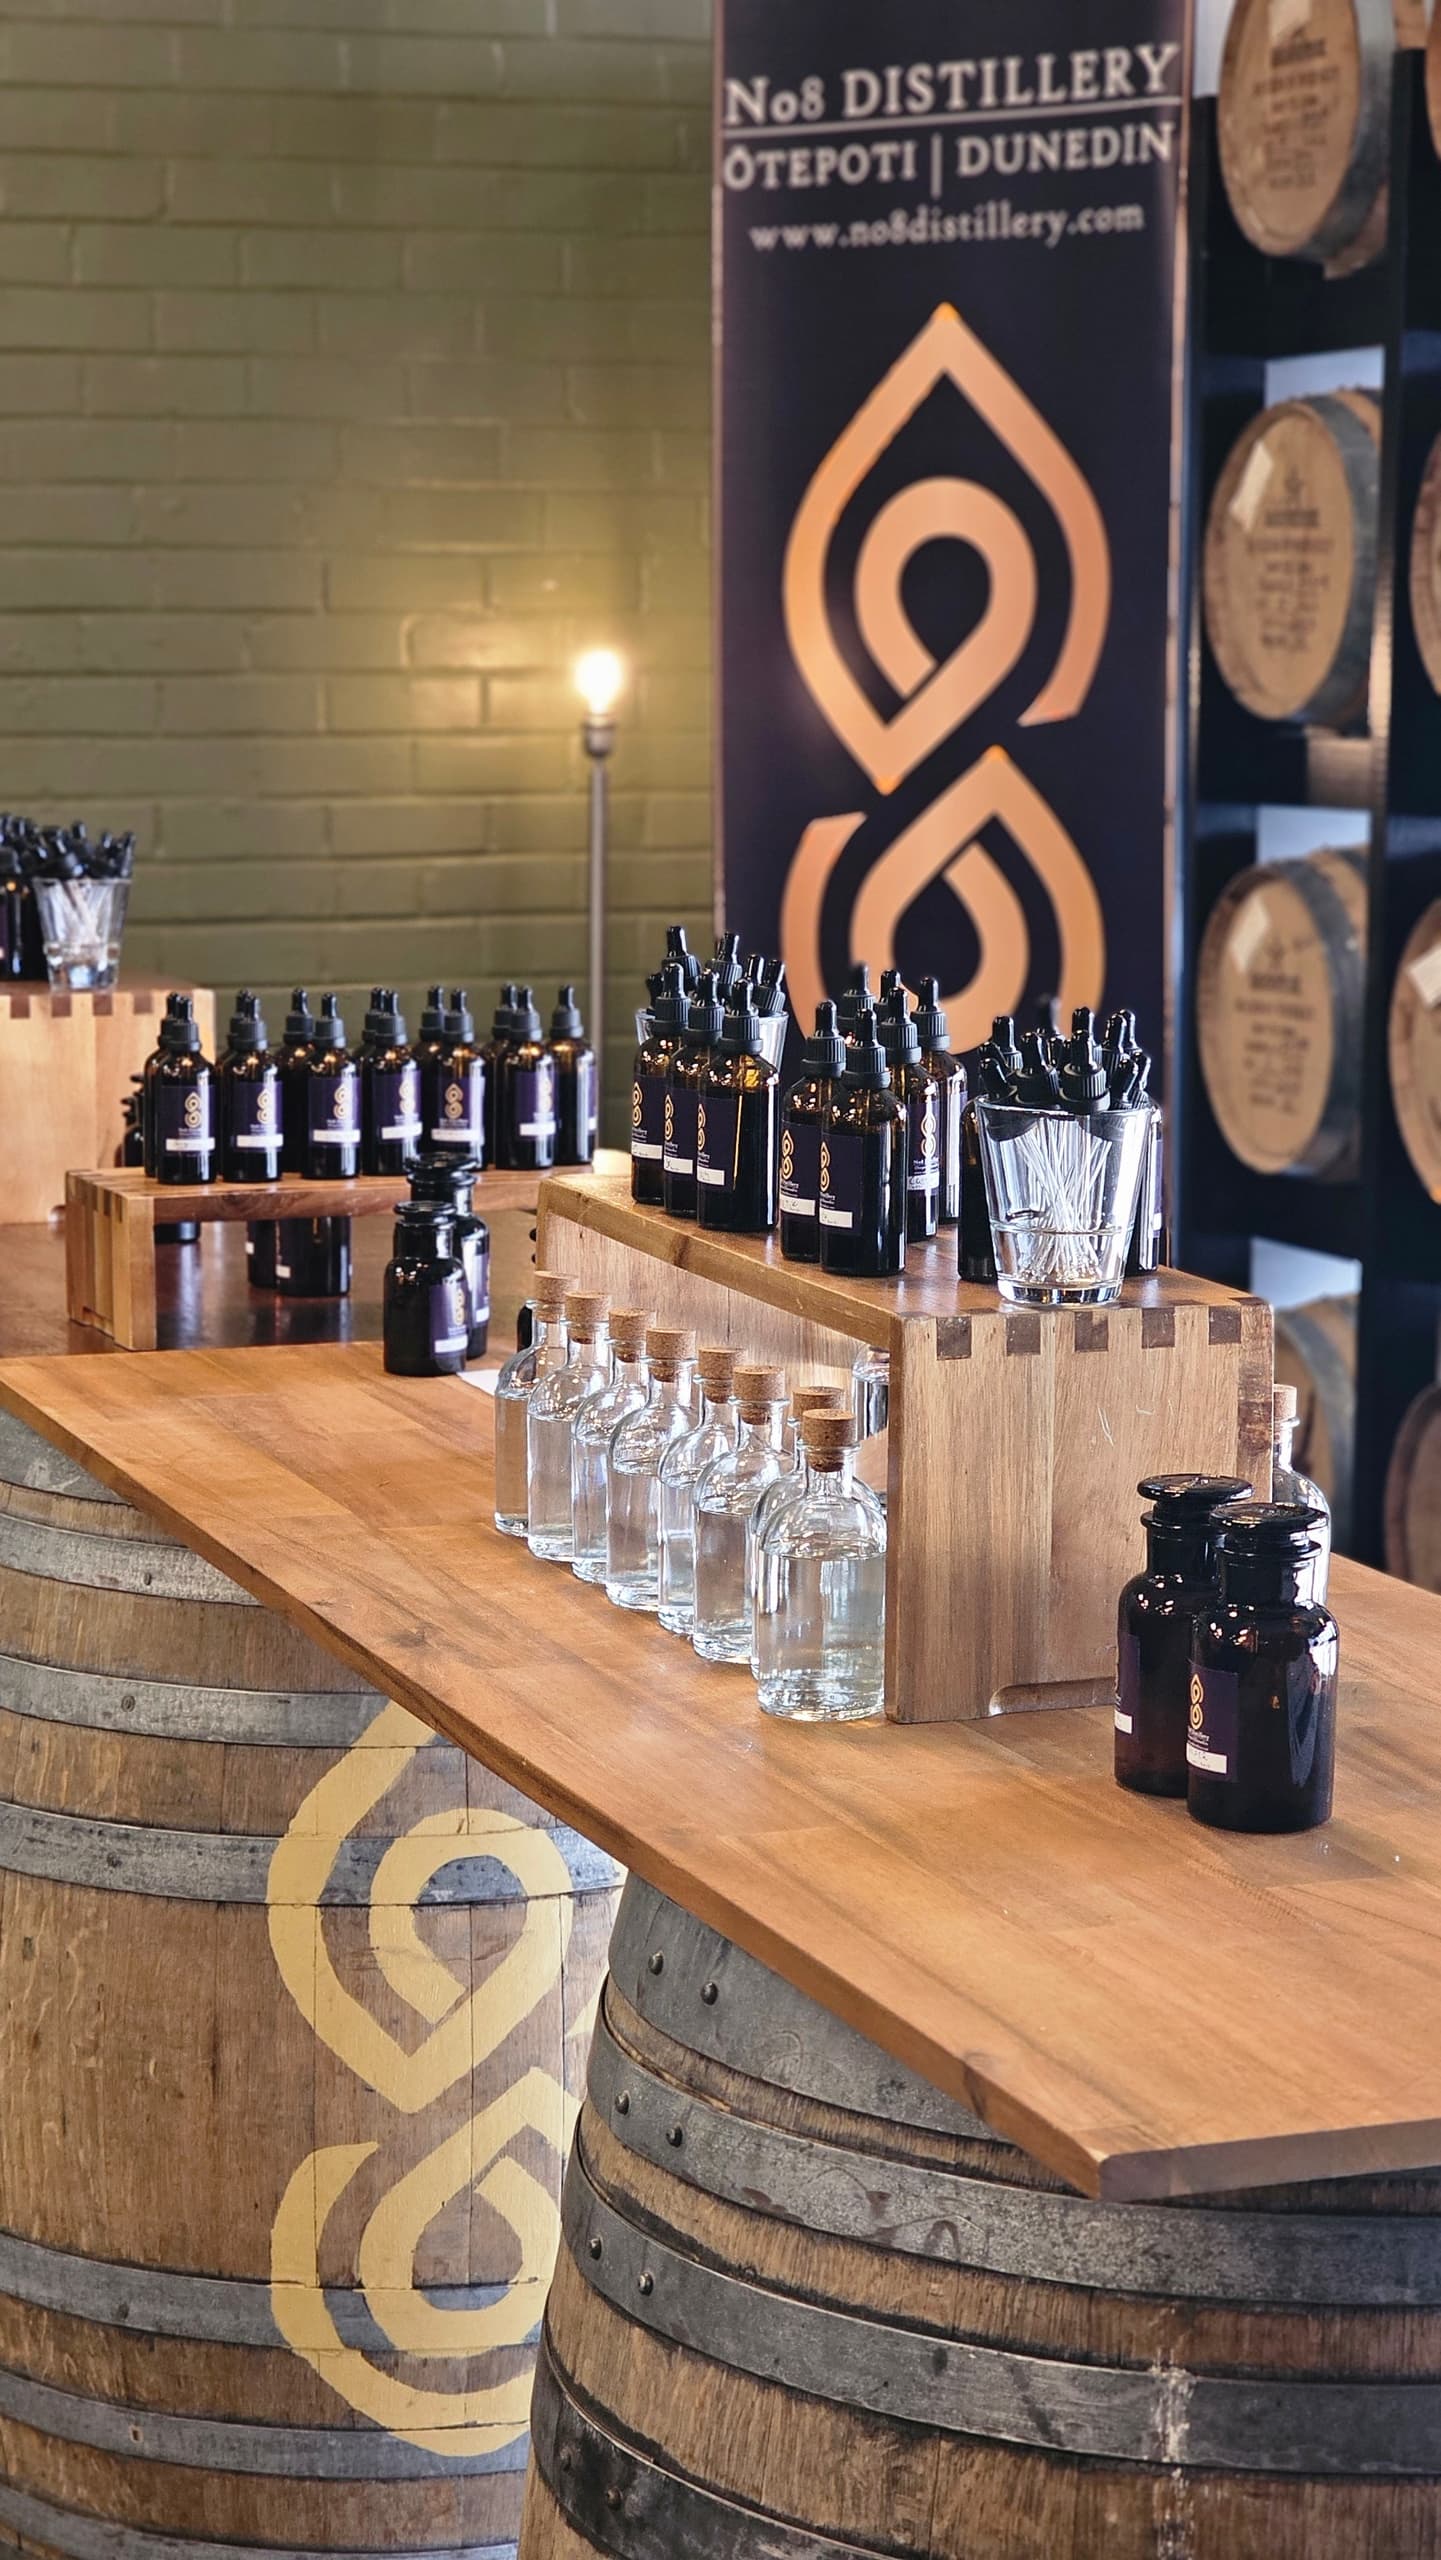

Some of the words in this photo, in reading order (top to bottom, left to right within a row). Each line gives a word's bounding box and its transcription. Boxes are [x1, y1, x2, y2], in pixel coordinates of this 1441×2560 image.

[724, 75, 824, 126] No8
[841, 43, 1178, 118] DISTILLERY
[956, 121, 1174, 177] DUNEDIN
[749, 200, 1145, 249] www.no8distillery.com
